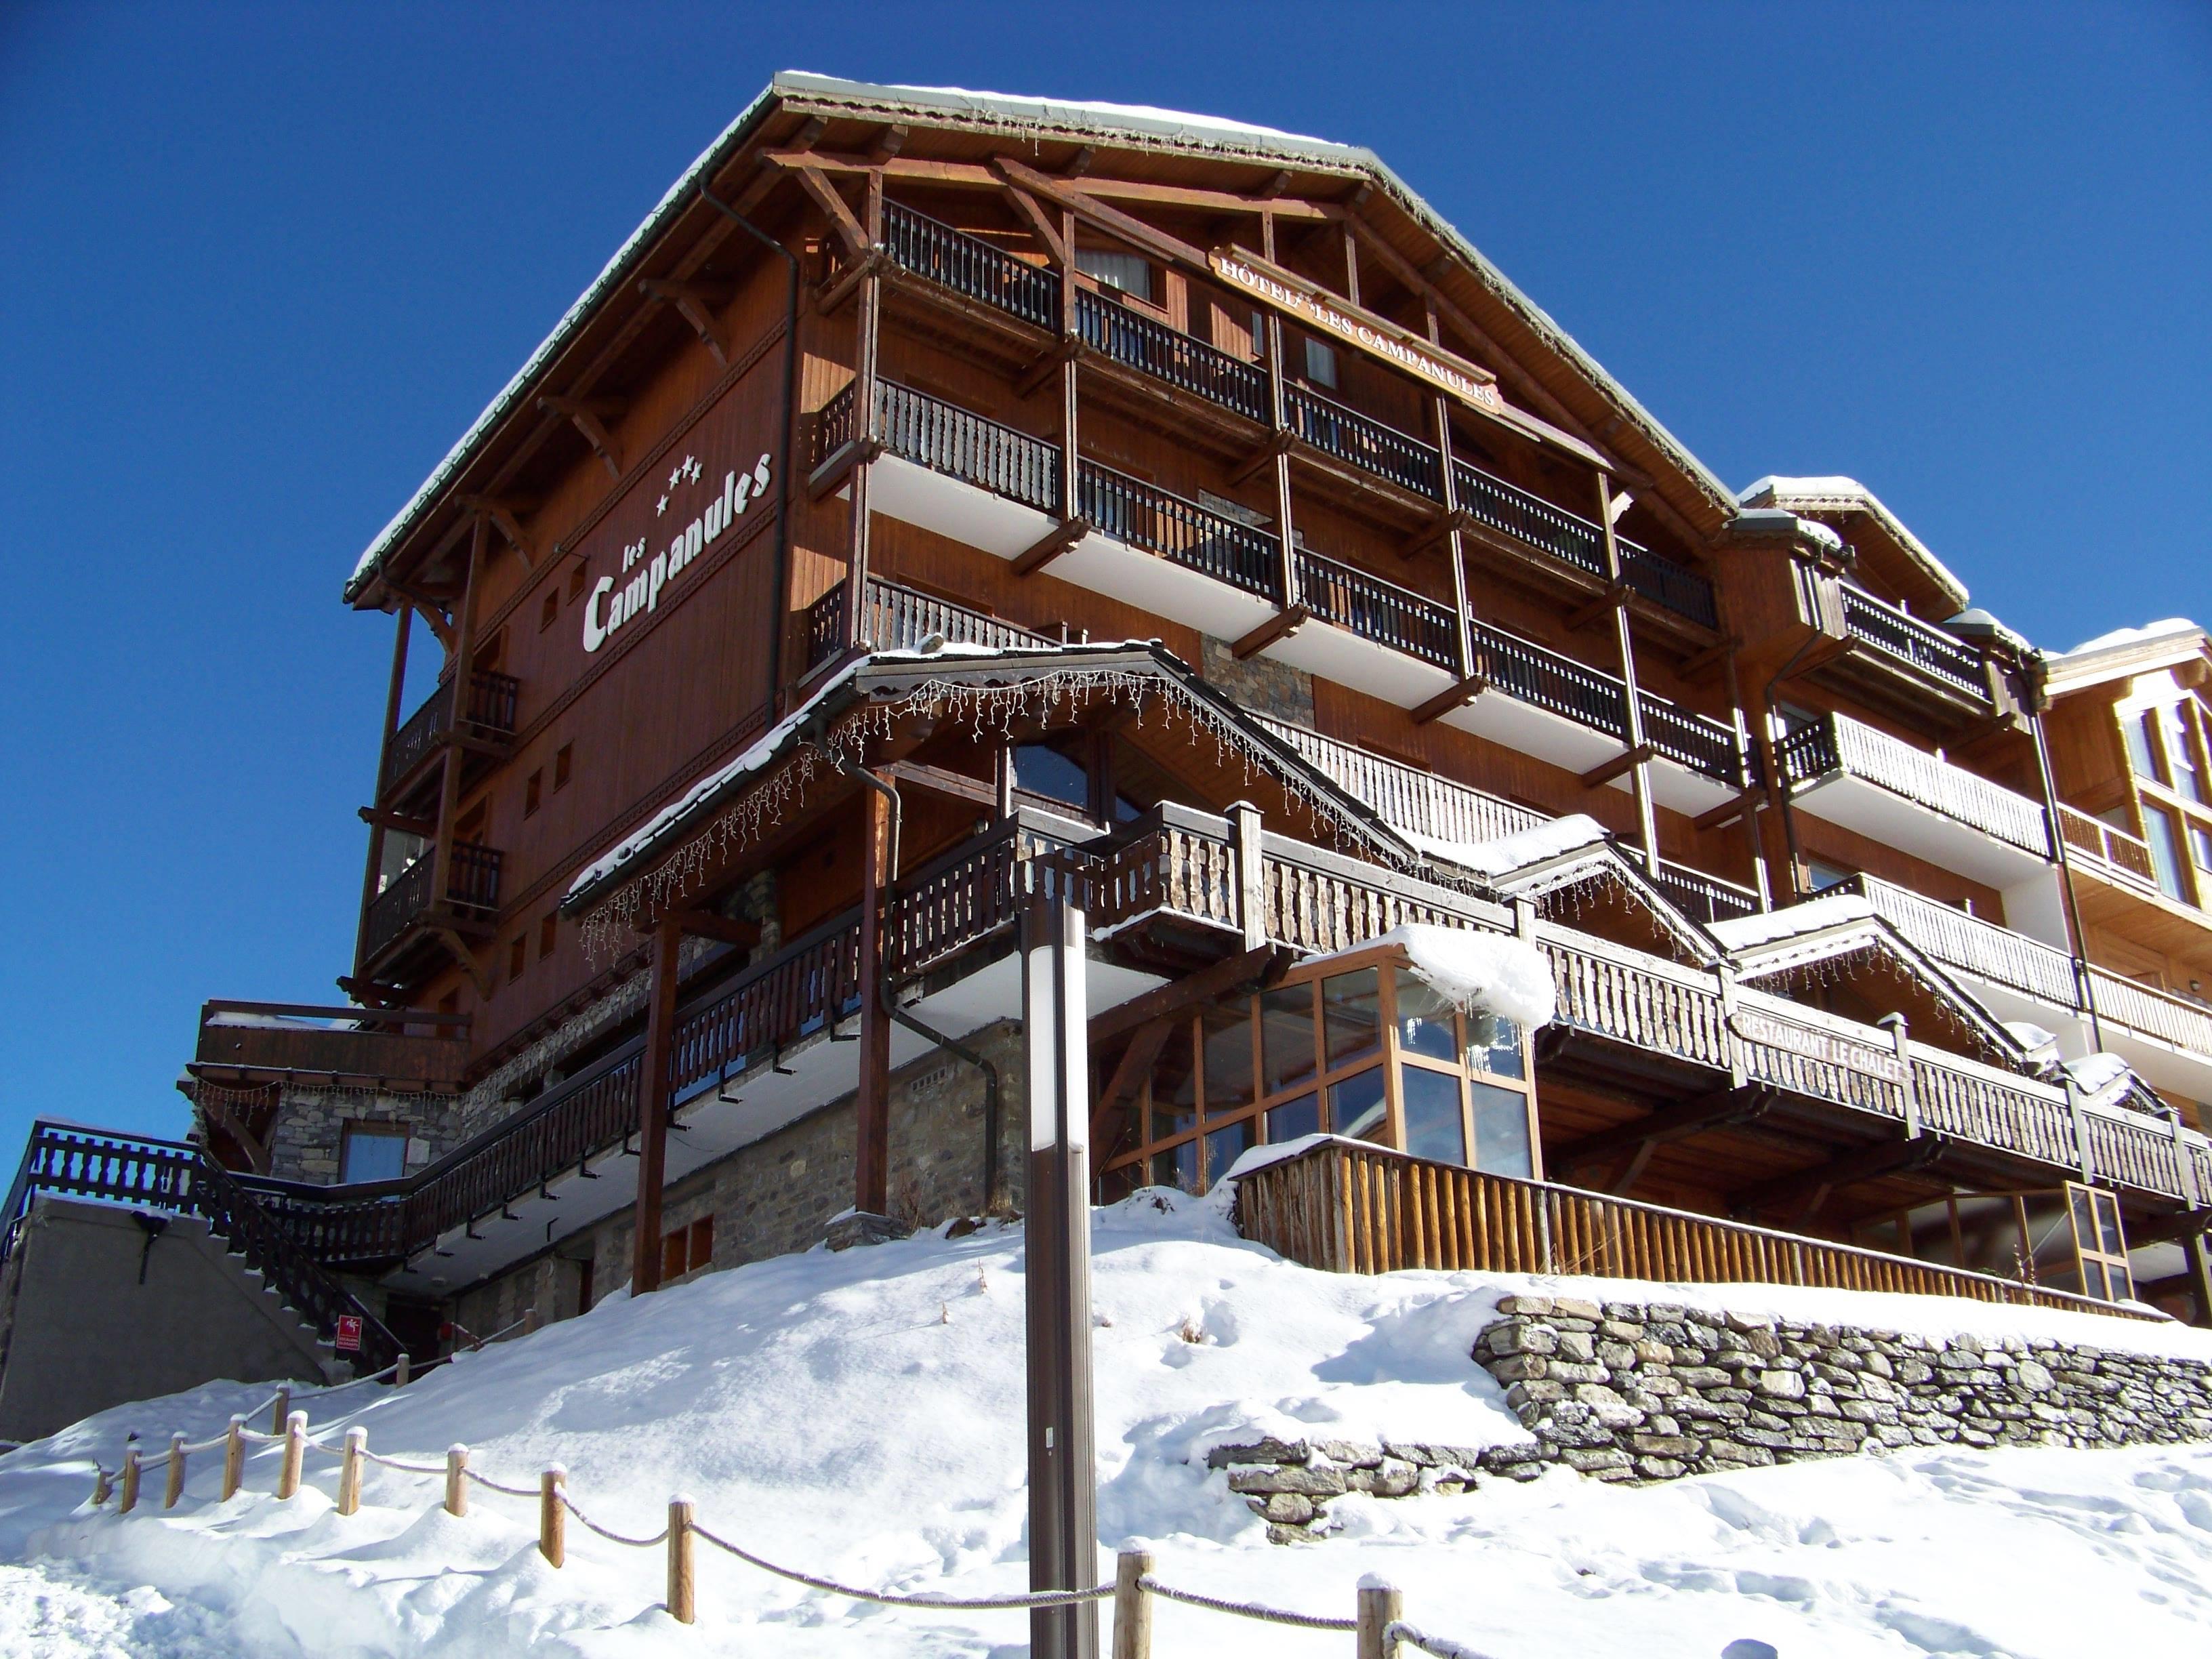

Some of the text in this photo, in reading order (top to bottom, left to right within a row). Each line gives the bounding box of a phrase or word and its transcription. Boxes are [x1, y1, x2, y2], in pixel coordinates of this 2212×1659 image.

[1220, 258, 1494, 406] HÔTEL LES CAMPANULES
[583, 453, 771, 652] Campanules
[1743, 1016, 1902, 1080] RESTAURANT LE CHALET
